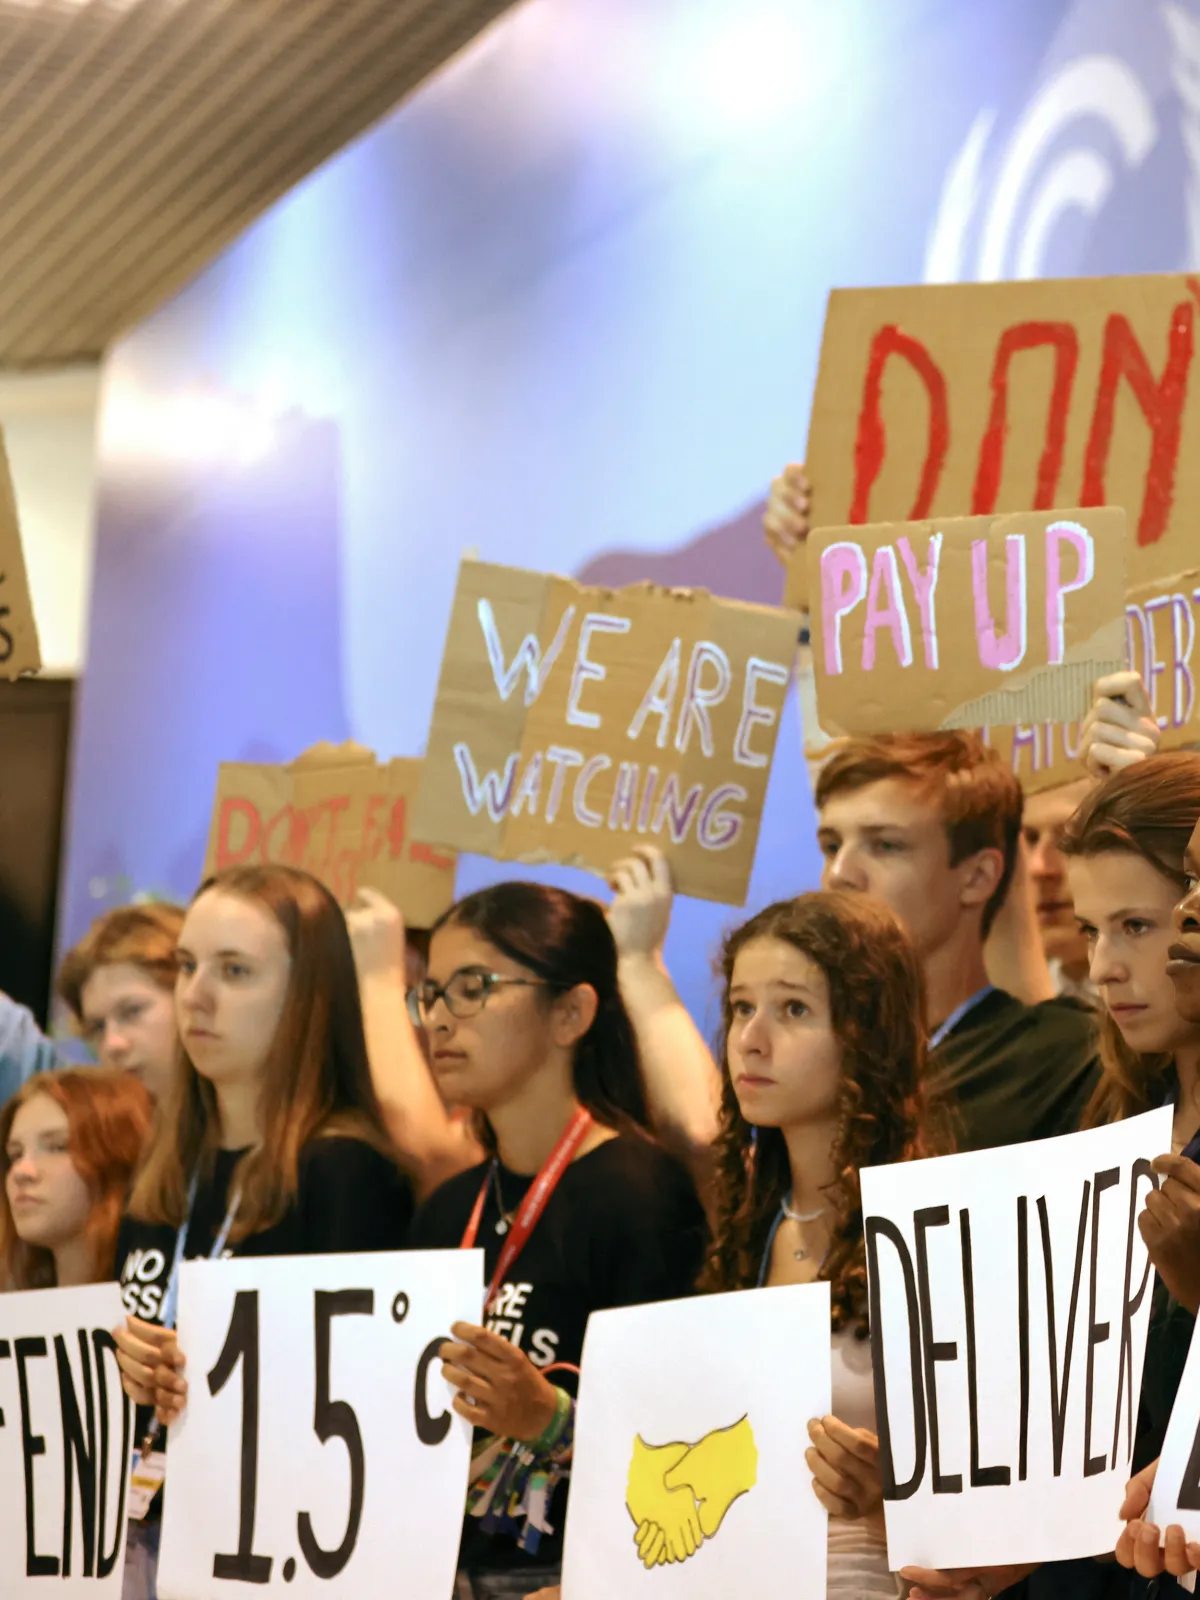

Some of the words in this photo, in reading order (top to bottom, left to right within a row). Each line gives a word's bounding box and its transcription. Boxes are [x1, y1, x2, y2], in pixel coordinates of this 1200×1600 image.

[820, 541, 943, 676] PAY
[971, 520, 1094, 672] UP
[477, 597, 632, 728] WE
[626, 636, 789, 768] ARE
[453, 742, 747, 850] WATCHING
[119, 1248, 166, 1283] NO
[865, 1157, 1160, 1501] DELIVER
[0, 1327, 131, 1580] END
